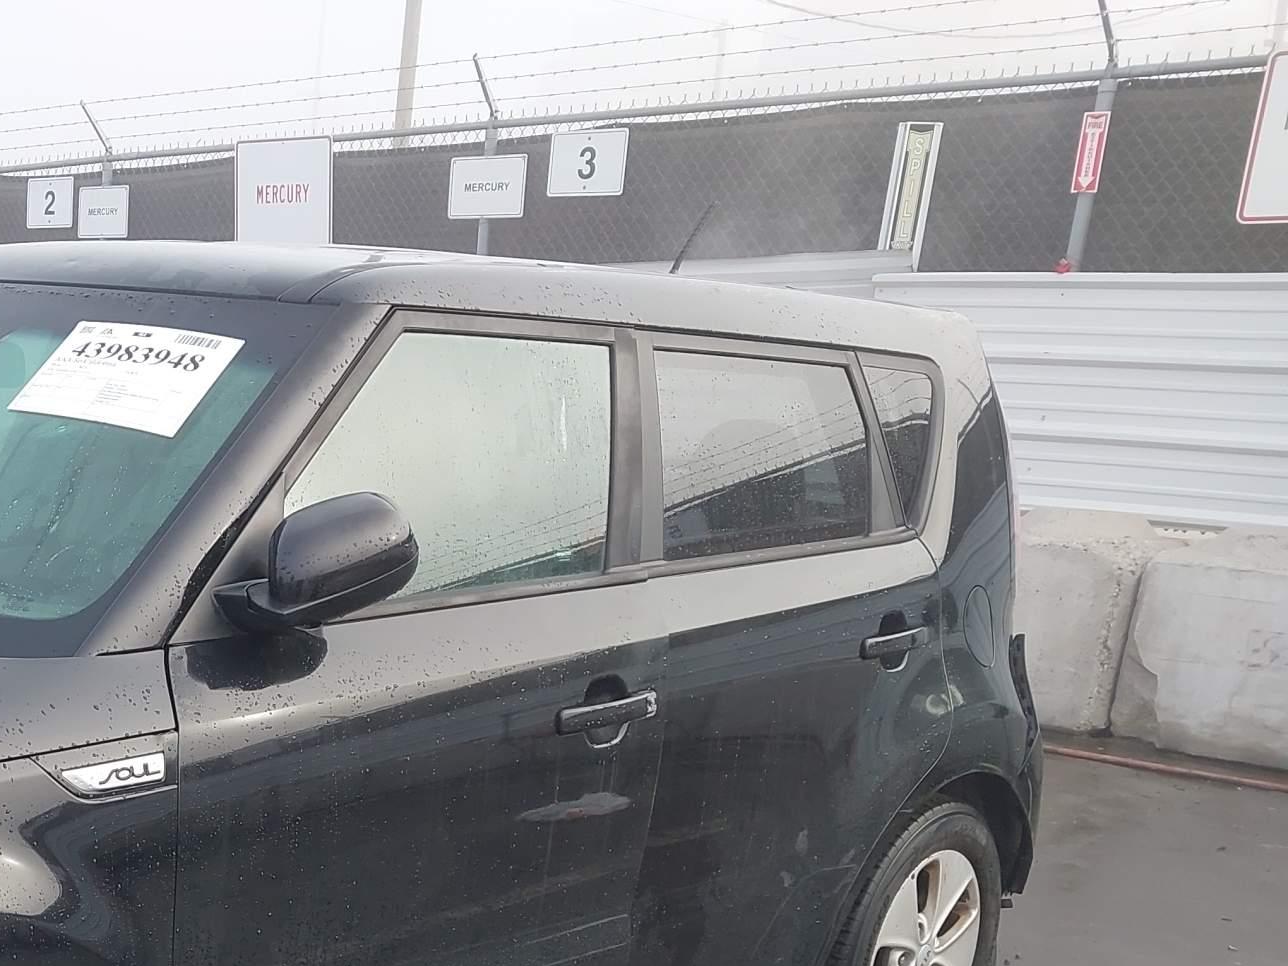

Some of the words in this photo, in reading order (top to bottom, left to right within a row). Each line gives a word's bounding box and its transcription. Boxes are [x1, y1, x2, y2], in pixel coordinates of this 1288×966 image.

[577, 147, 597, 180] 3
[256, 183, 310, 205] MERCURY
[464, 181, 511, 193] MERCURY
[899, 138, 923, 238] SPILL
[44, 190, 56, 215] 2
[87, 207, 119, 216] MERCURY
[72, 341, 206, 372] 43983948
[98, 762, 161, 785] SOUL
